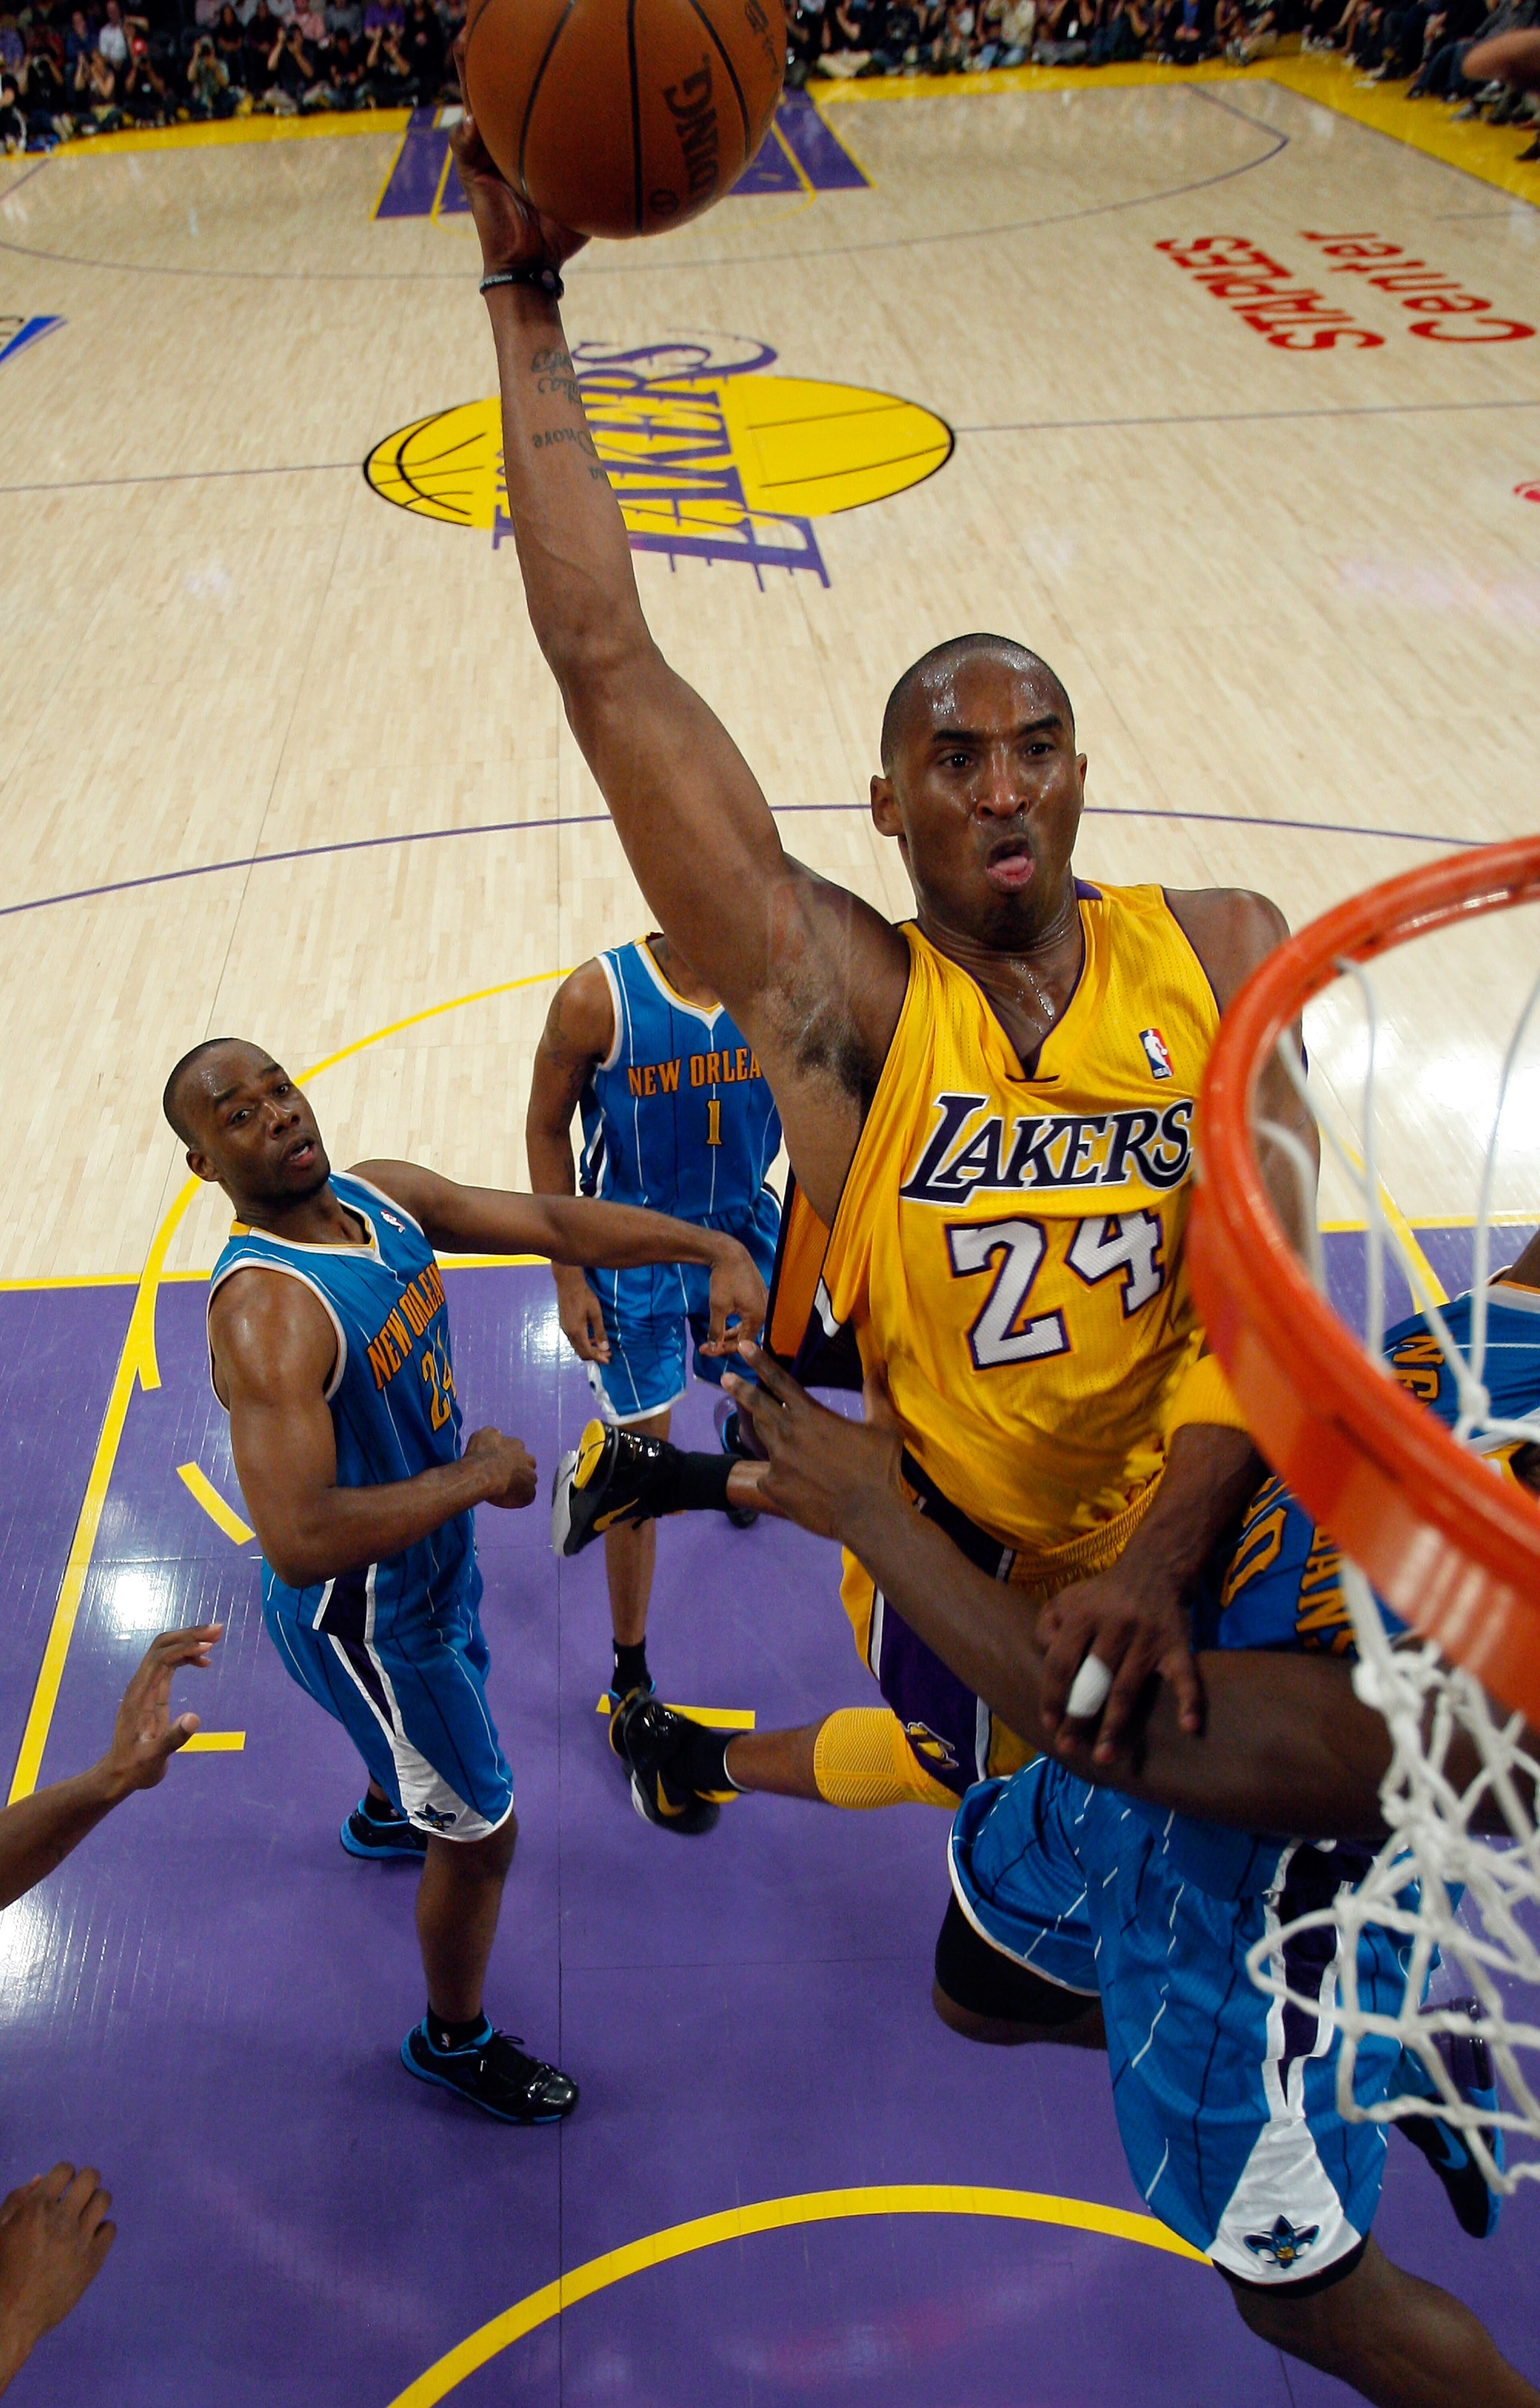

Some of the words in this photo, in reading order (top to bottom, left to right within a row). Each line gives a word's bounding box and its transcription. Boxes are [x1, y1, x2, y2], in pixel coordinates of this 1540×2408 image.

[1154, 236, 1386, 351] STAPLES
[1297, 231, 1536, 345] Center
[627, 1057, 681, 1097] NEW
[706, 1099, 722, 1146] 1
[899, 1091, 1194, 1207] LAKERS
[944, 1208, 1165, 1371] 24
[367, 1307, 413, 1390] NEW
[421, 1325, 457, 1433] 24
